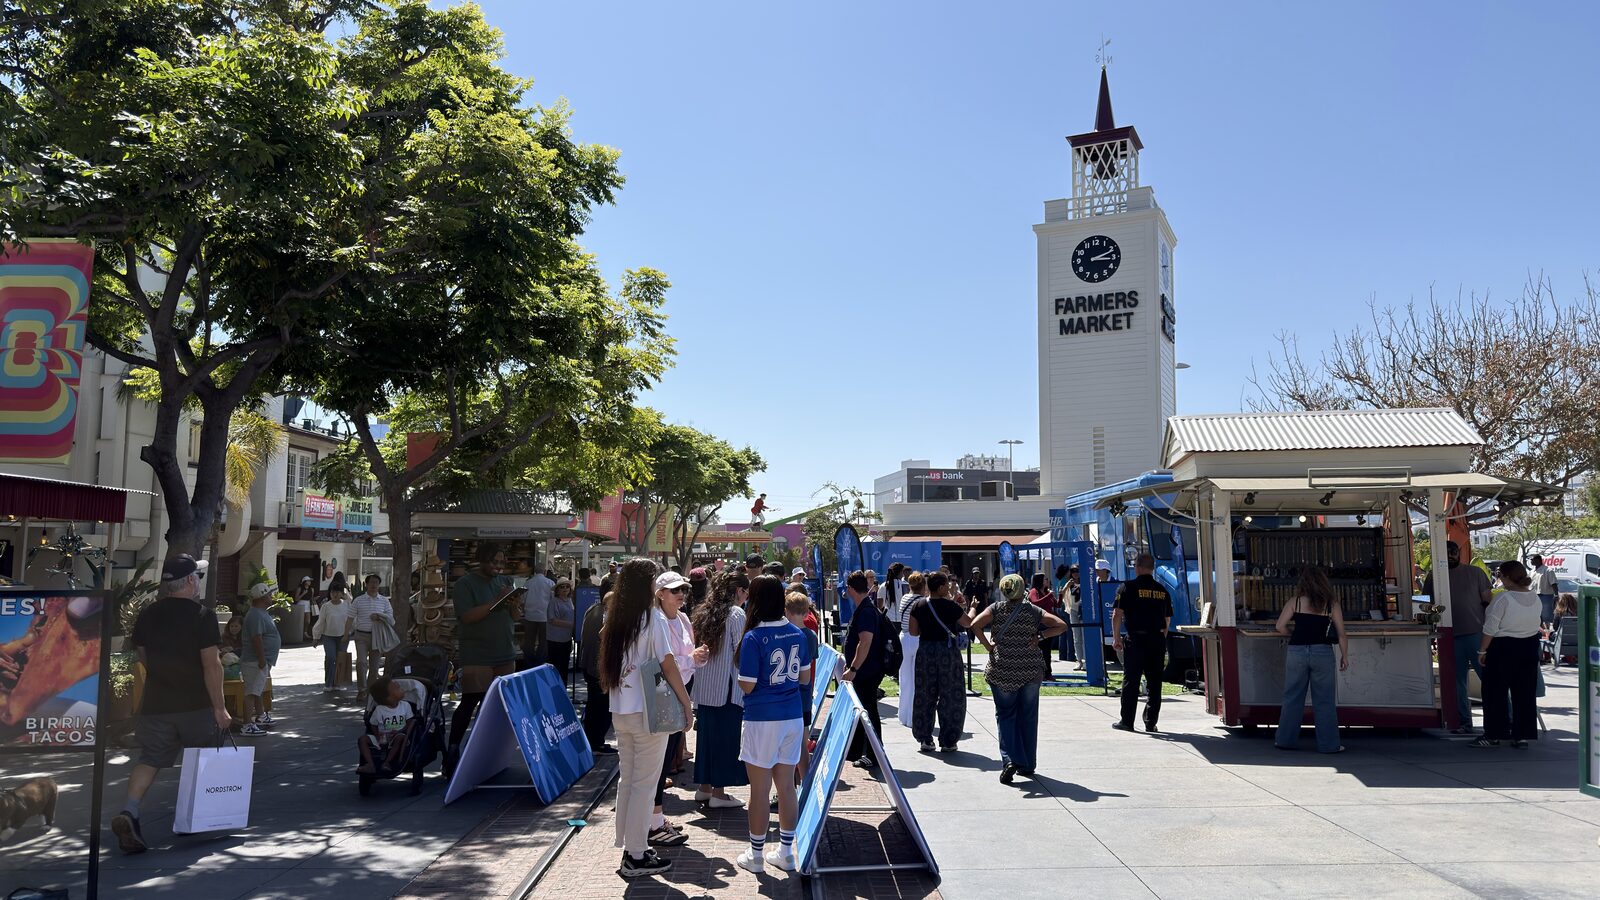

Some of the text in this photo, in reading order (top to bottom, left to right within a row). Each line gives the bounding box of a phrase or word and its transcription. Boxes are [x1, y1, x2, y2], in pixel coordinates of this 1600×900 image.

[1055, 290, 1139, 315] FARMERS
[1059, 311, 1134, 335] MARKET
[930, 471, 964, 480] us bank
[321, 502, 335, 514] ZONE
[1541, 555, 1566, 567] yder
[1138, 589, 1167, 600] EVENT STAFF
[1, 598, 46, 615] ES!
[770, 644, 800, 685] 26
[26, 716, 95, 730] BIRRIA
[384, 715, 404, 726] GAP
[550, 713, 565, 727] Kaiser
[28, 730, 95, 743] TACOS
[205, 785, 243, 794] NORDSTROM
